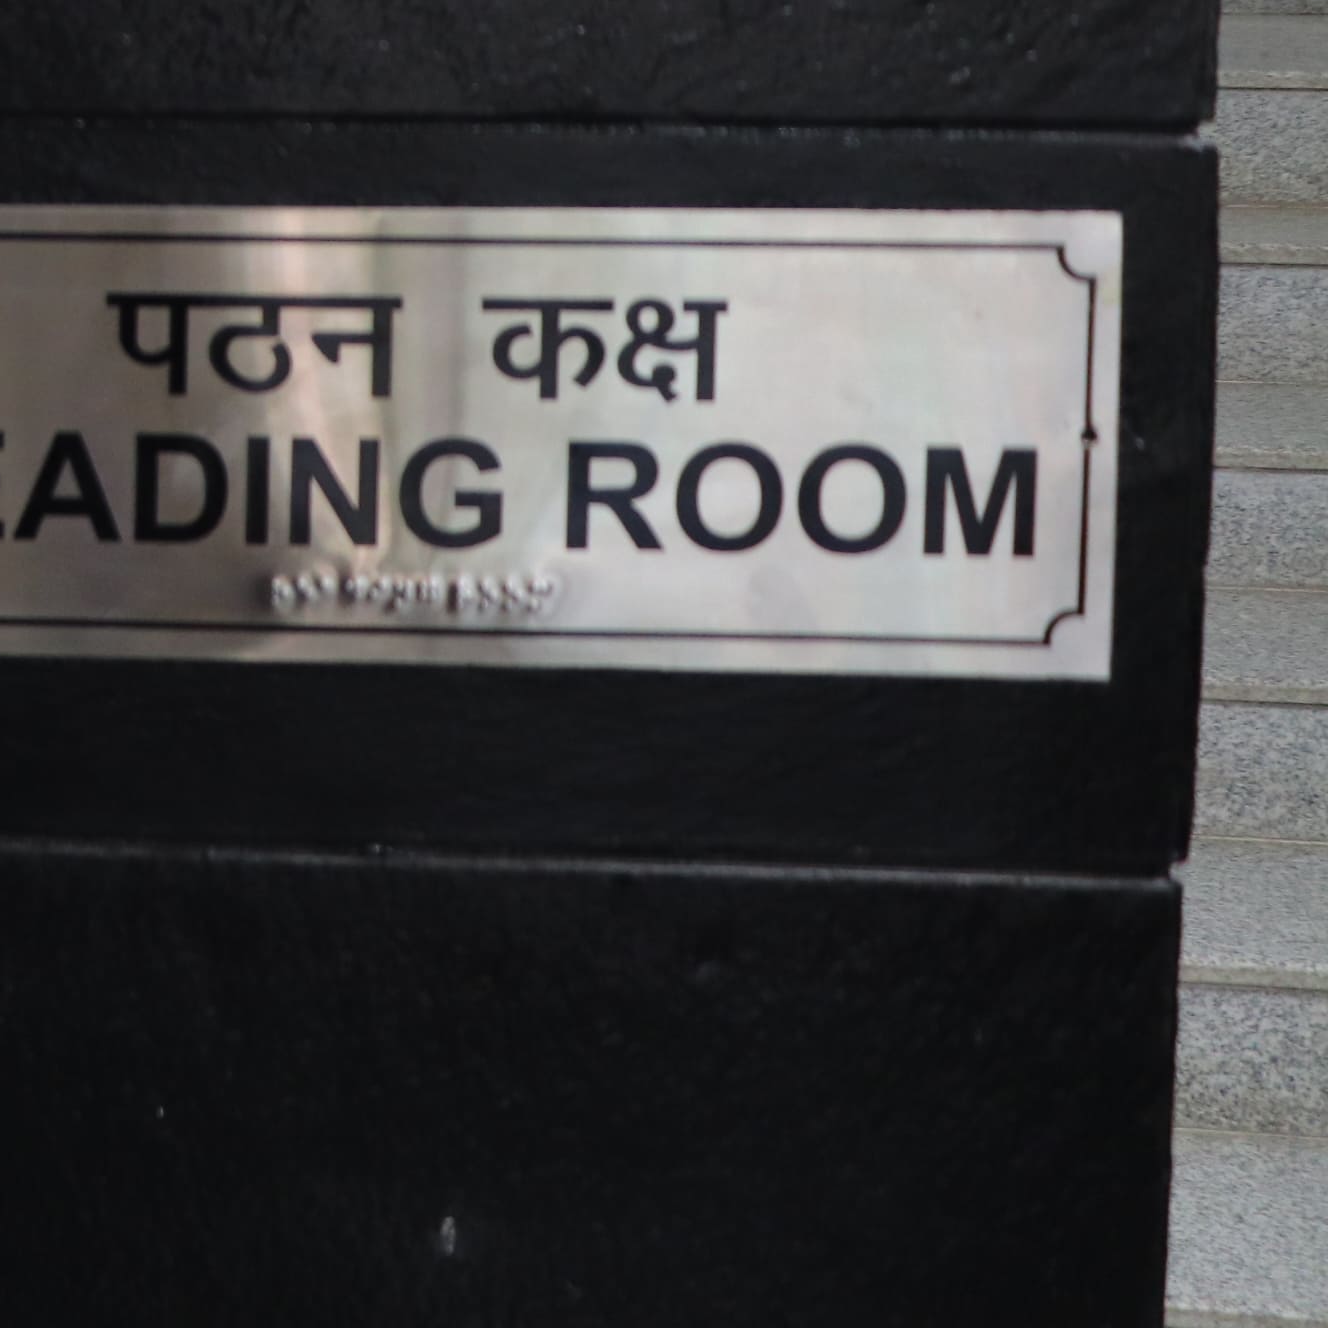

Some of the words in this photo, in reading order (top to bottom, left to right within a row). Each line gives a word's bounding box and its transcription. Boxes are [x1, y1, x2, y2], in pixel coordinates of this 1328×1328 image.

[105, 291, 404, 400] पठन
[481, 296, 728, 403] कक्ष
[565, 440, 1038, 558] ROOM
